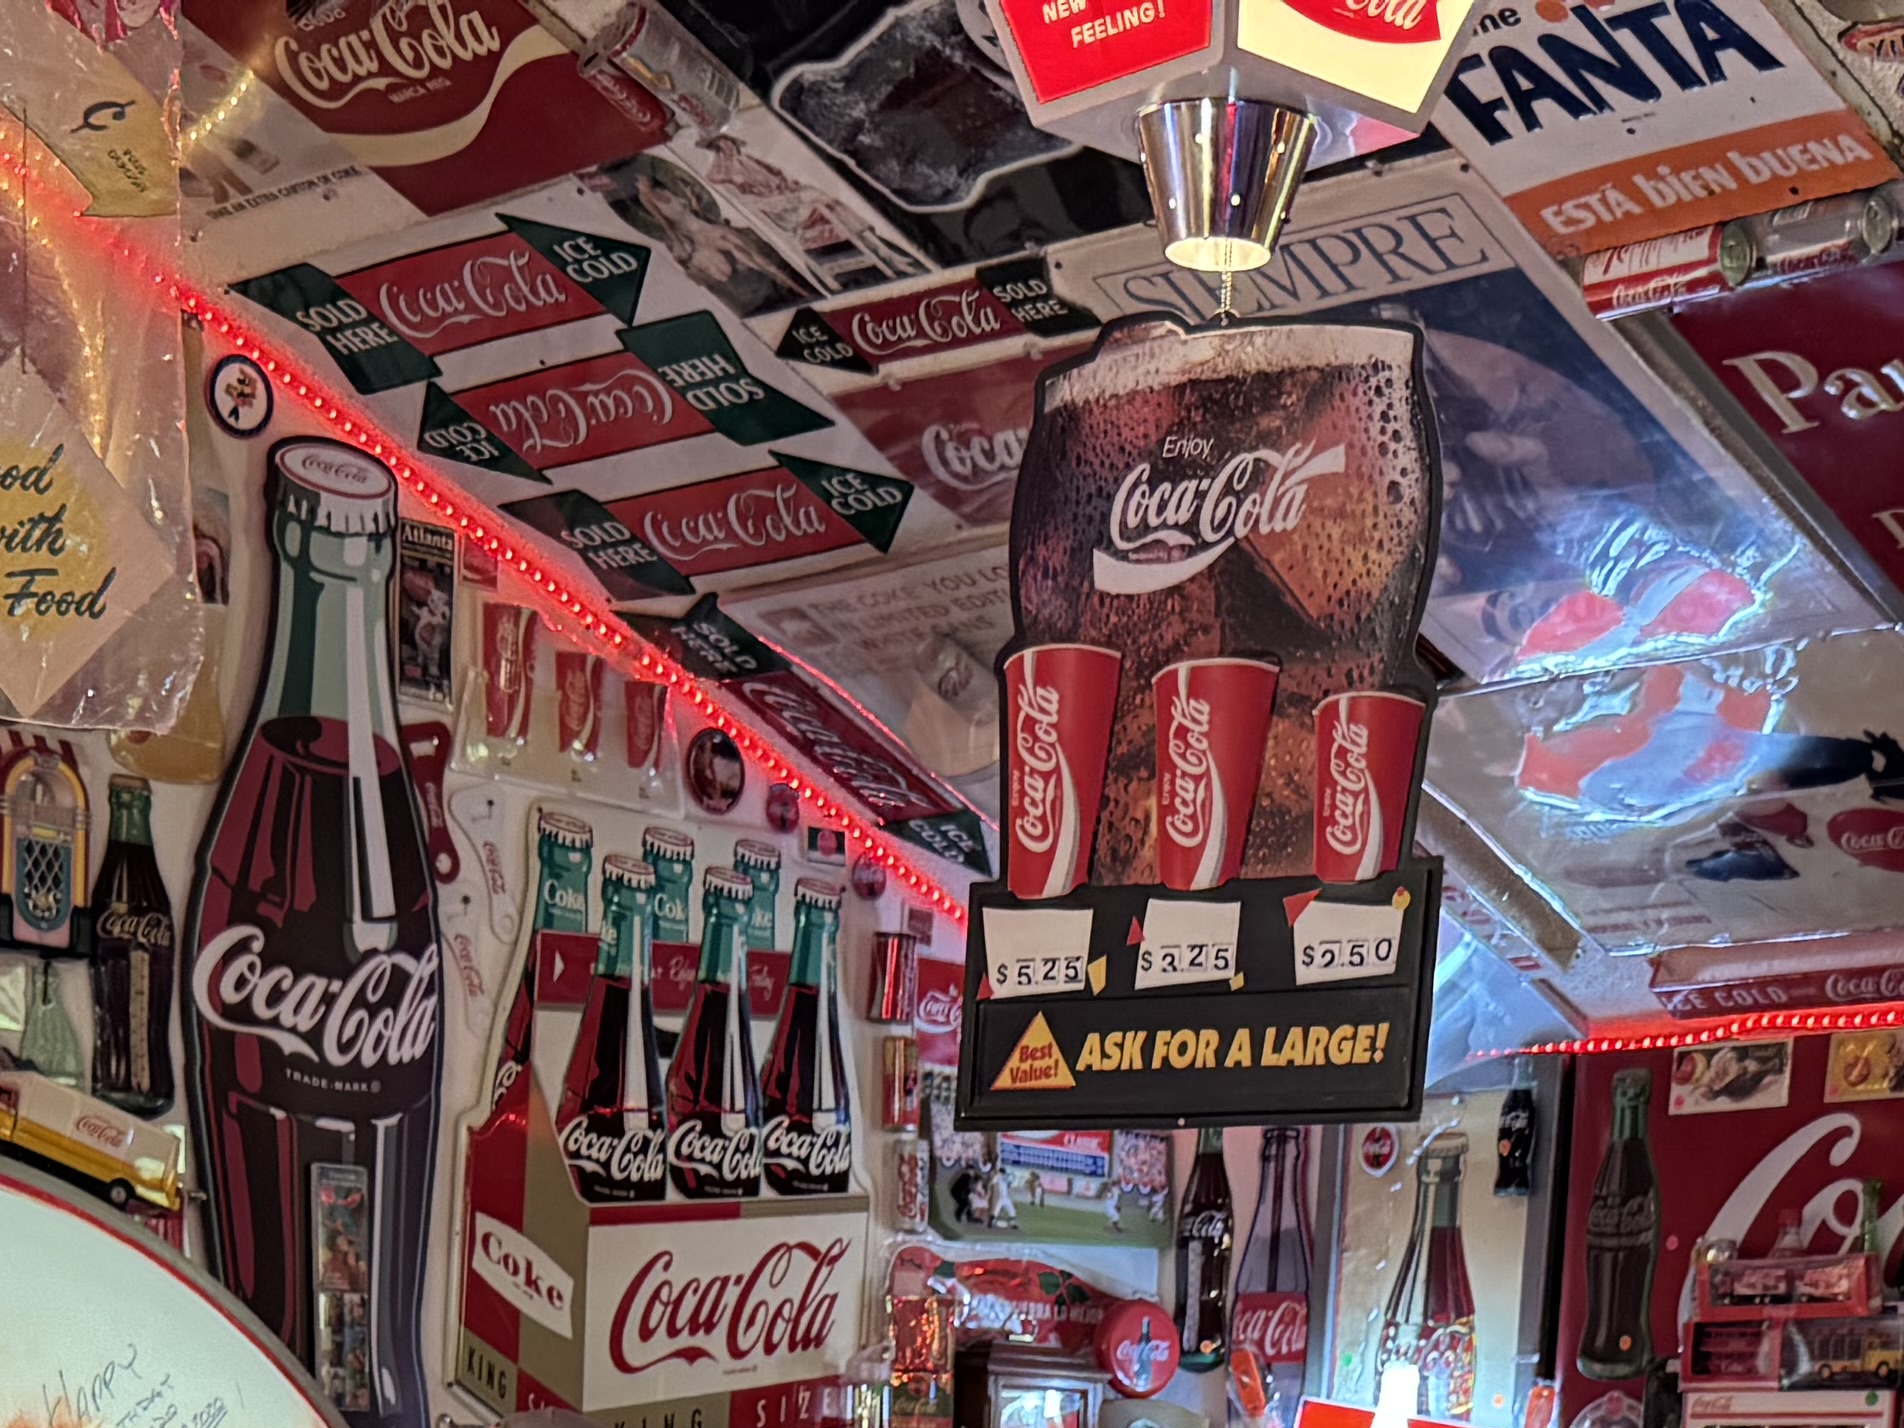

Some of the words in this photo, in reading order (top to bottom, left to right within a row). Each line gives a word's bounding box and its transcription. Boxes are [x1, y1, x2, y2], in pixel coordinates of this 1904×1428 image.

[1071, 2, 1165, 48] FEELING!
[1447, 0, 1784, 143] FANTA
[553, 234, 601, 264] ICE
[566, 248, 642, 286] COLD
[378, 250, 568, 338] Coca-Cola
[993, 277, 1049, 304] SOLD
[296, 298, 367, 332] SOLD
[1010, 296, 1068, 325] HERE
[326, 321, 397, 356] HERE
[791, 322, 825, 345] ICE
[802, 335, 853, 366] COLD
[658, 352, 738, 387] HERE
[693, 377, 767, 414] SOLD
[424, 426, 487, 448] COLD
[455, 440, 499, 462] ICE
[1162, 434, 1214, 460] Enjoy
[821, 474, 859, 503] ICE
[830, 484, 904, 521] COLD
[643, 472, 827, 558] Coca-Cola
[560, 521, 630, 551] SOLD
[587, 542, 658, 576] HERE
[0, 566, 117, 622] Food
[543, 881, 586, 911] Coke
[192, 923, 439, 1068] Coca-Cola
[1716, 985, 1790, 1008] COLD
[1019, 1043, 1054, 1066] Best
[1076, 1033, 1146, 1072] ASK
[1152, 1030, 1217, 1070] FOR
[1224, 1029, 1253, 1068] A
[1259, 1022, 1389, 1068] LARGE!
[1010, 1061, 1061, 1084] Value!
[480, 1228, 566, 1314] Coke
[609, 1236, 852, 1376] Coca-Cola
[467, 1346, 508, 1399] KING
